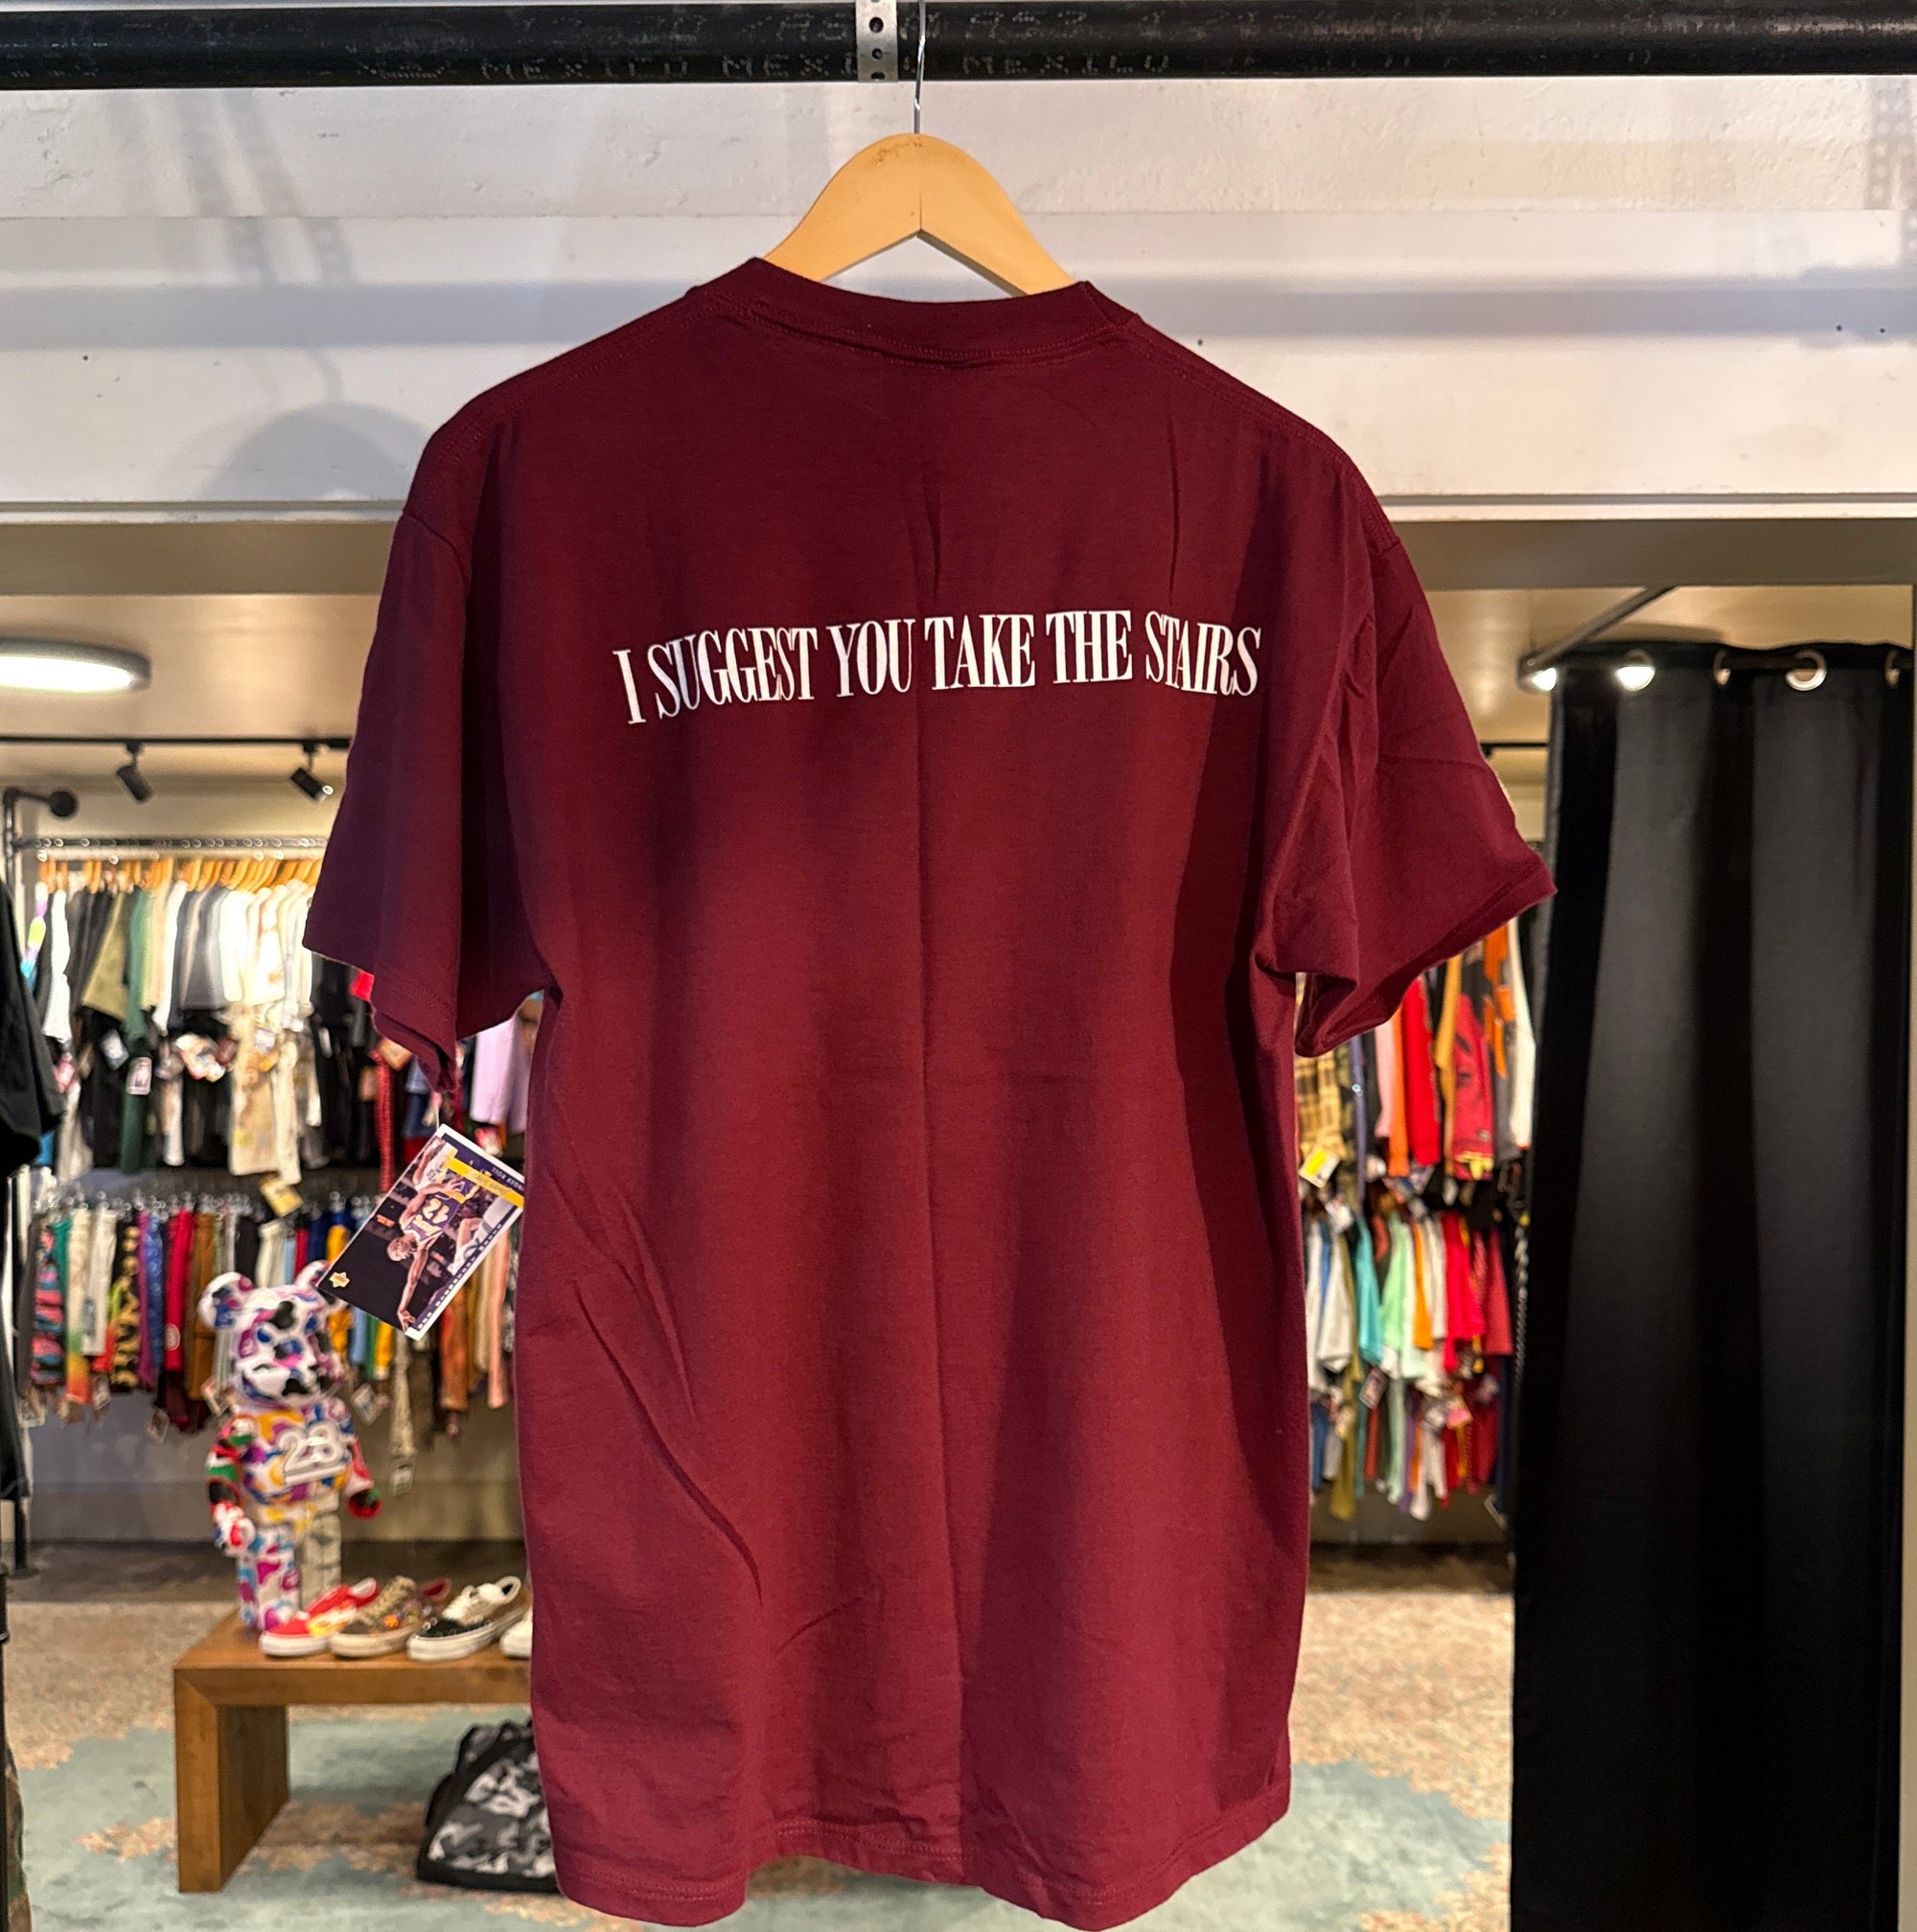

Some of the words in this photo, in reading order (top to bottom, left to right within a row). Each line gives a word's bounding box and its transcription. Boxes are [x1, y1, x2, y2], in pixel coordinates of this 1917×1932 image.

[722, 54, 924, 77] MEXIO
[961, 53, 1168, 76] MEXICO
[612, 649, 647, 724] I
[647, 627, 819, 720] SUGGEST
[825, 618, 916, 698] YOU
[924, 613, 1036, 691] TAKE
[1045, 610, 1133, 684] THE
[1144, 610, 1261, 697] STAIRS
[422, 1197, 450, 1224] 42
